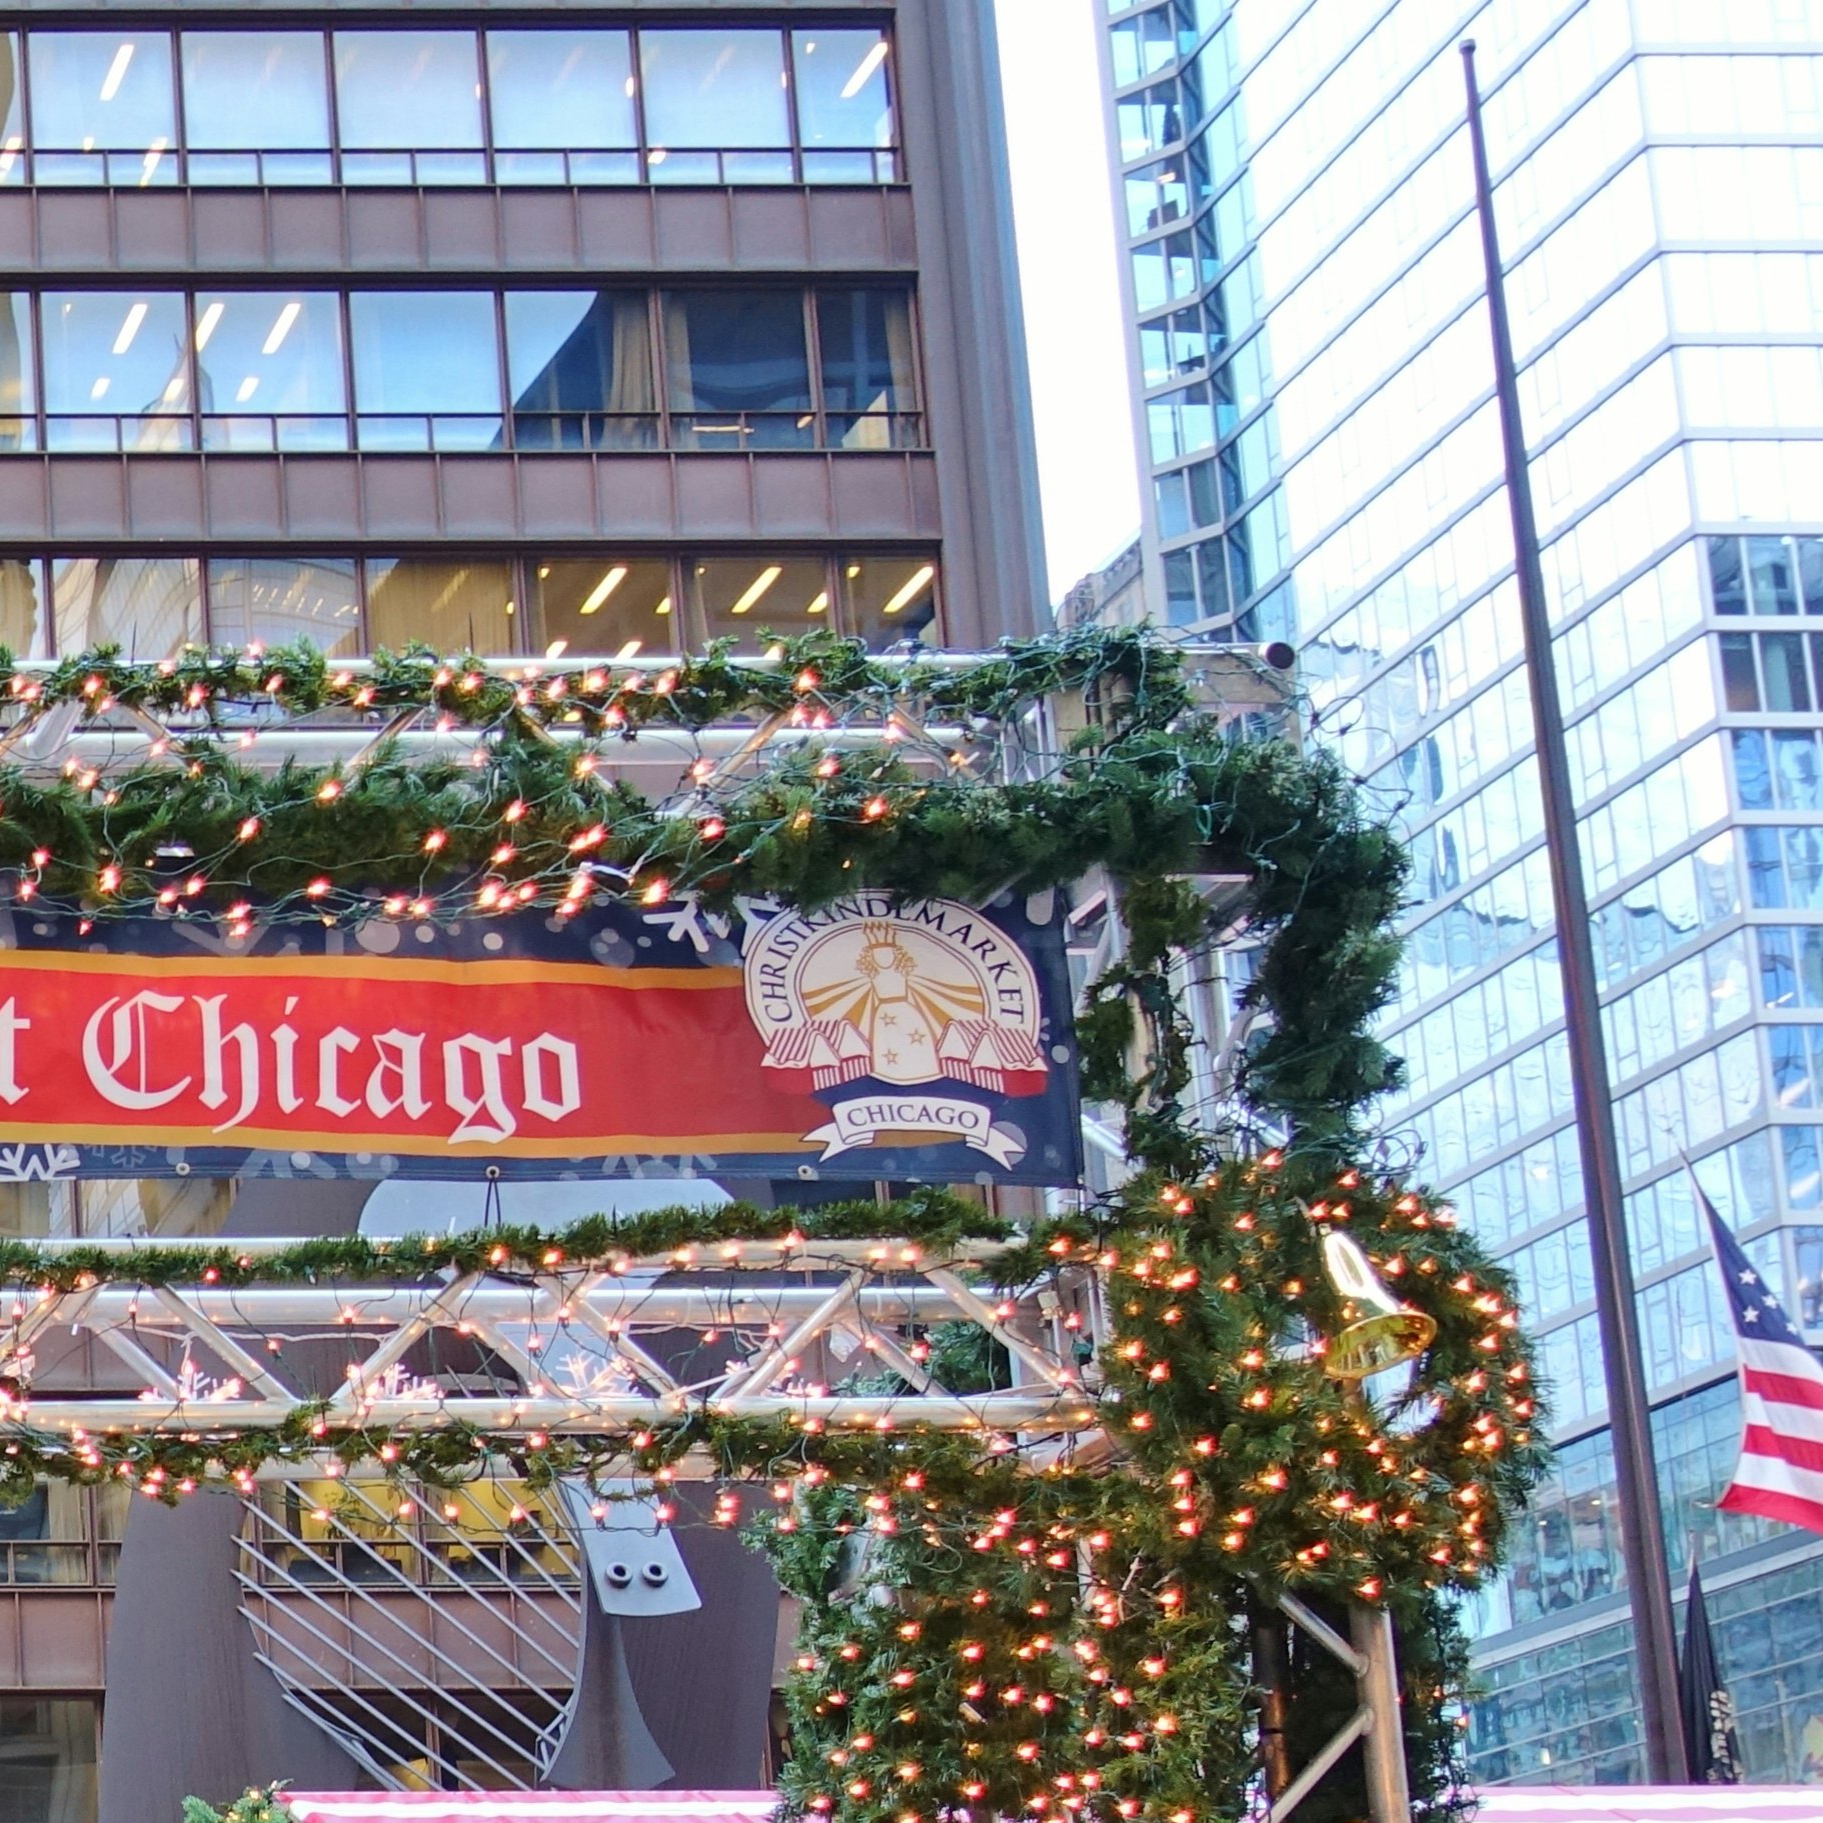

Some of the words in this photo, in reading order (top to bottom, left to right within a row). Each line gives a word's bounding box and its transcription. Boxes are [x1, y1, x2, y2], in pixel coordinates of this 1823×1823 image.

[759, 896, 1026, 1025] CHRISTKINDLMARKET
[80, 988, 585, 1145] Chicago
[847, 1104, 979, 1130] CHICAGO
